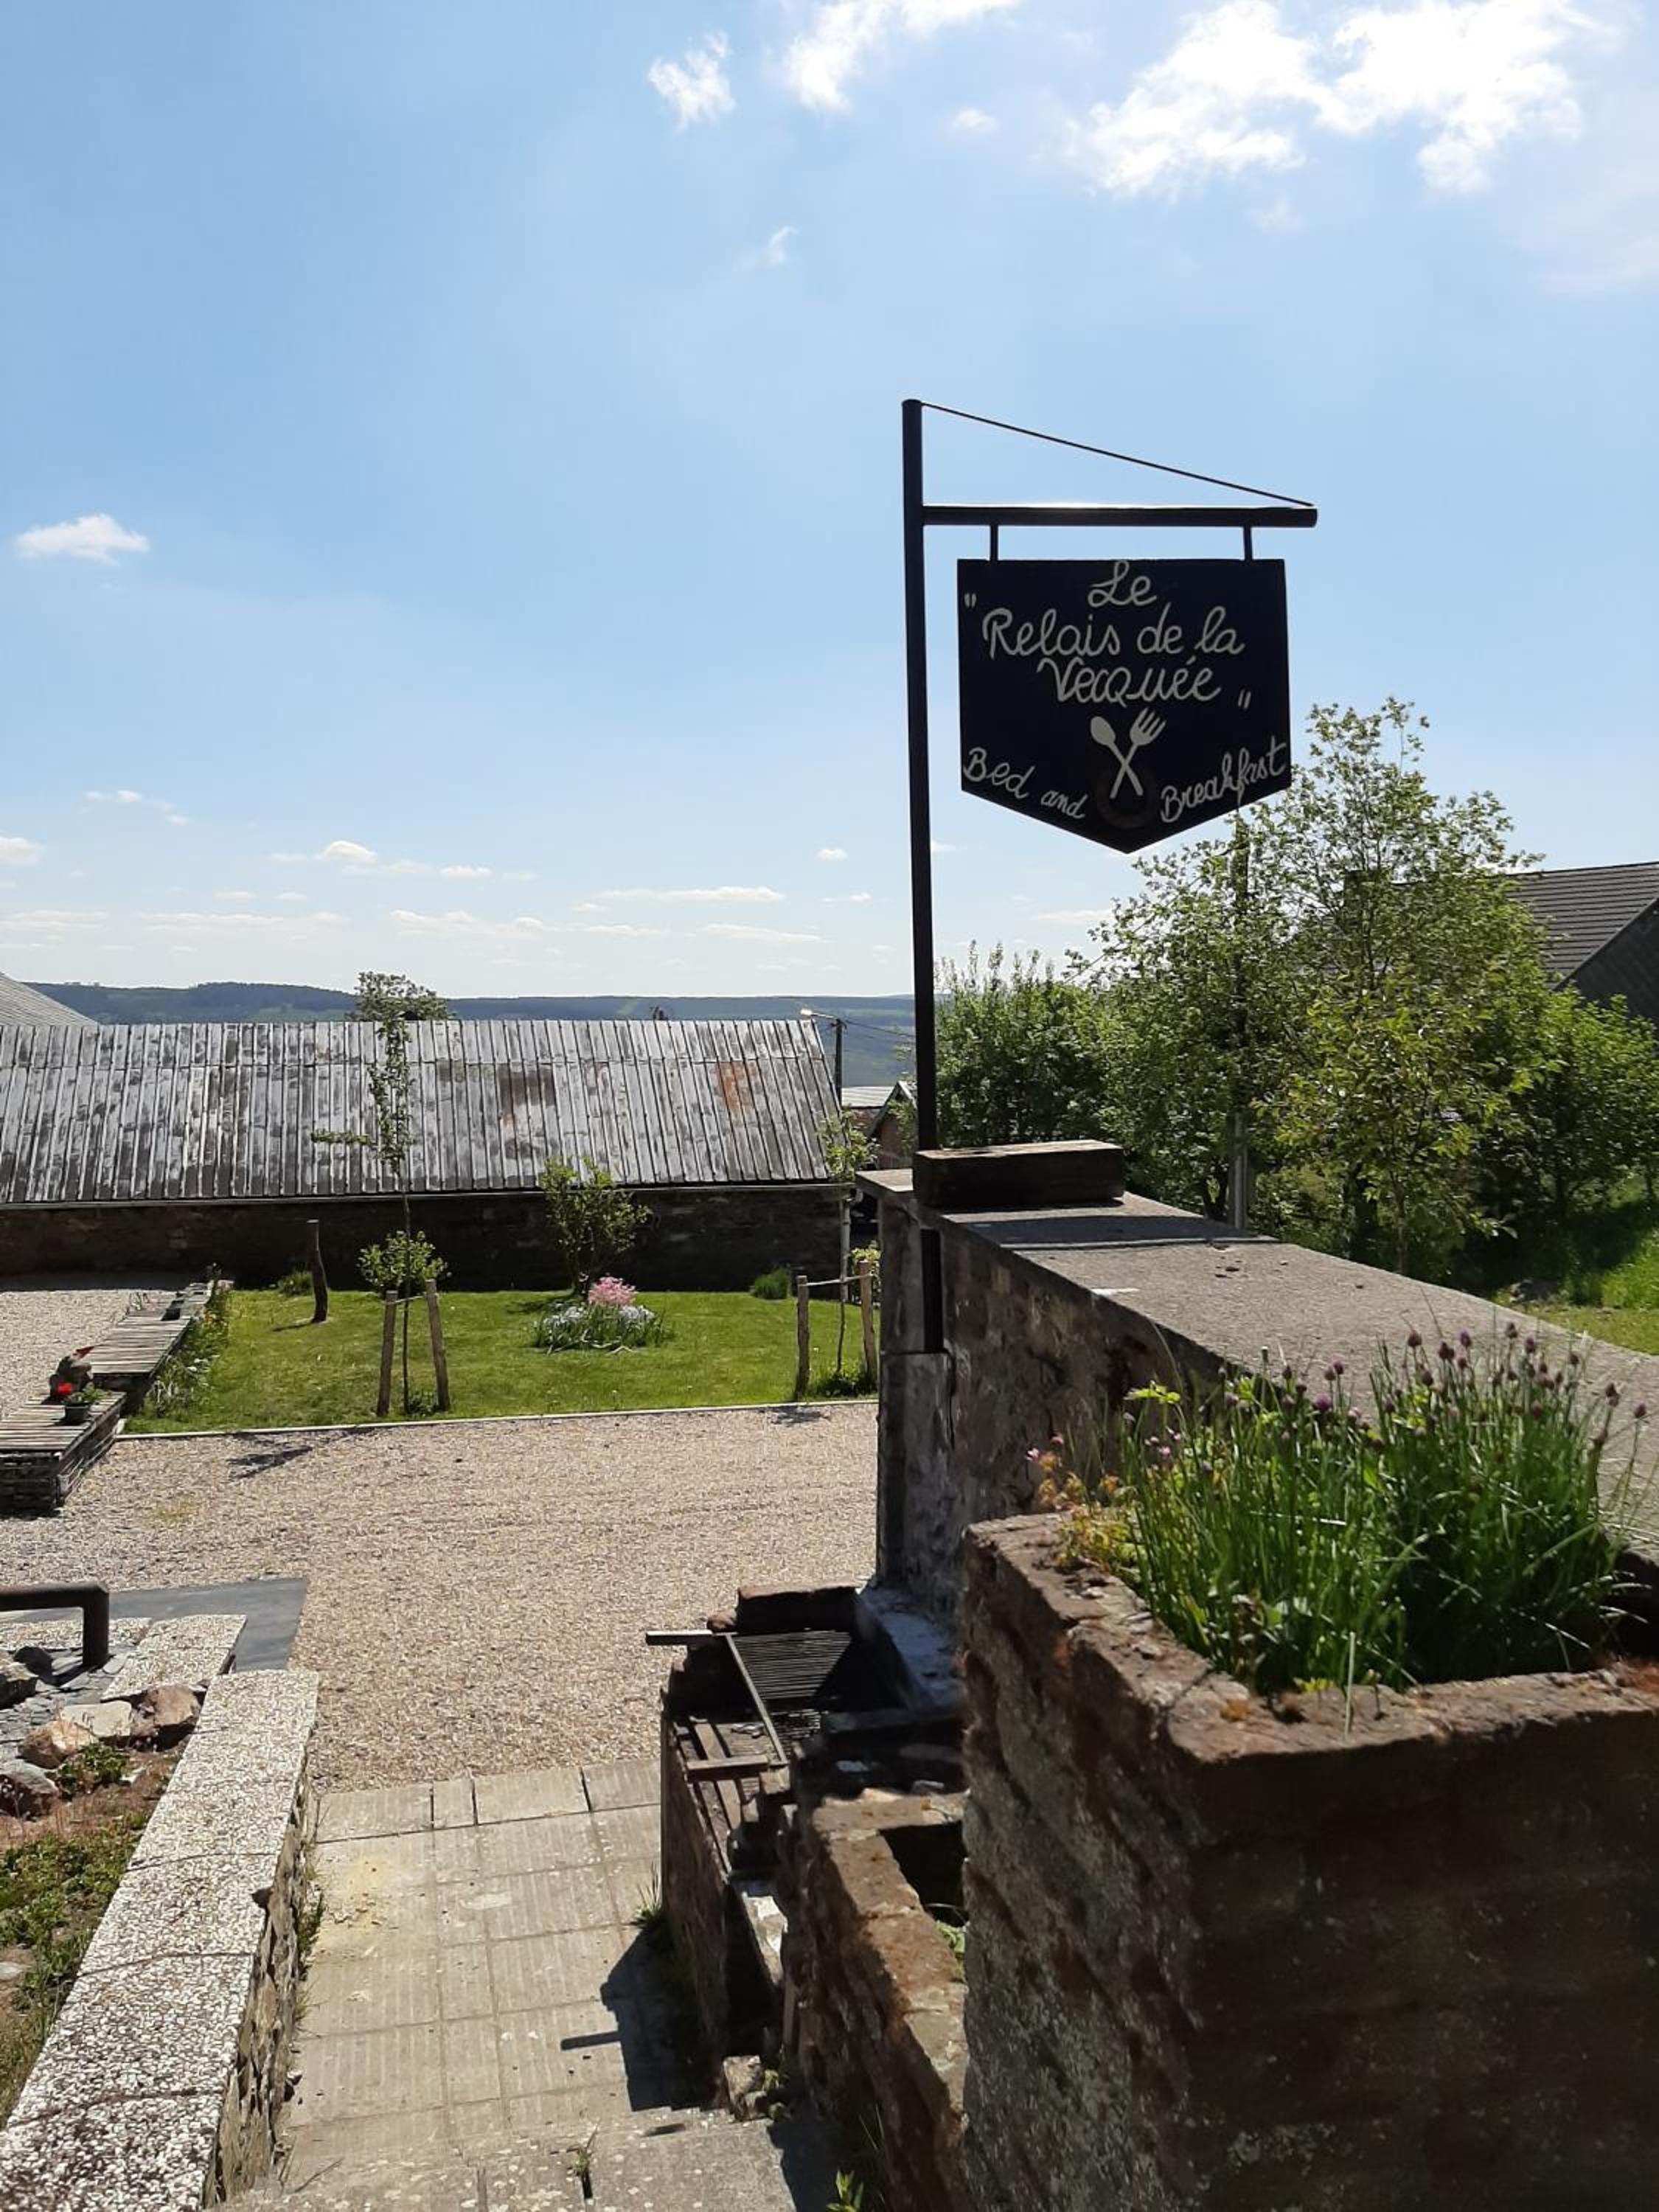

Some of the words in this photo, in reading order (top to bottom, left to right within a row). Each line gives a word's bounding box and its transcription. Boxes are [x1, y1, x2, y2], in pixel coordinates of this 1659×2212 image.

[1088, 560, 1158, 607] Le
[1136, 602, 1184, 655] de
[1194, 605, 1246, 655] la
[963, 747, 1036, 799] Bed
[1040, 790, 1089, 818] and
[1160, 735, 1287, 823] Breakfast
